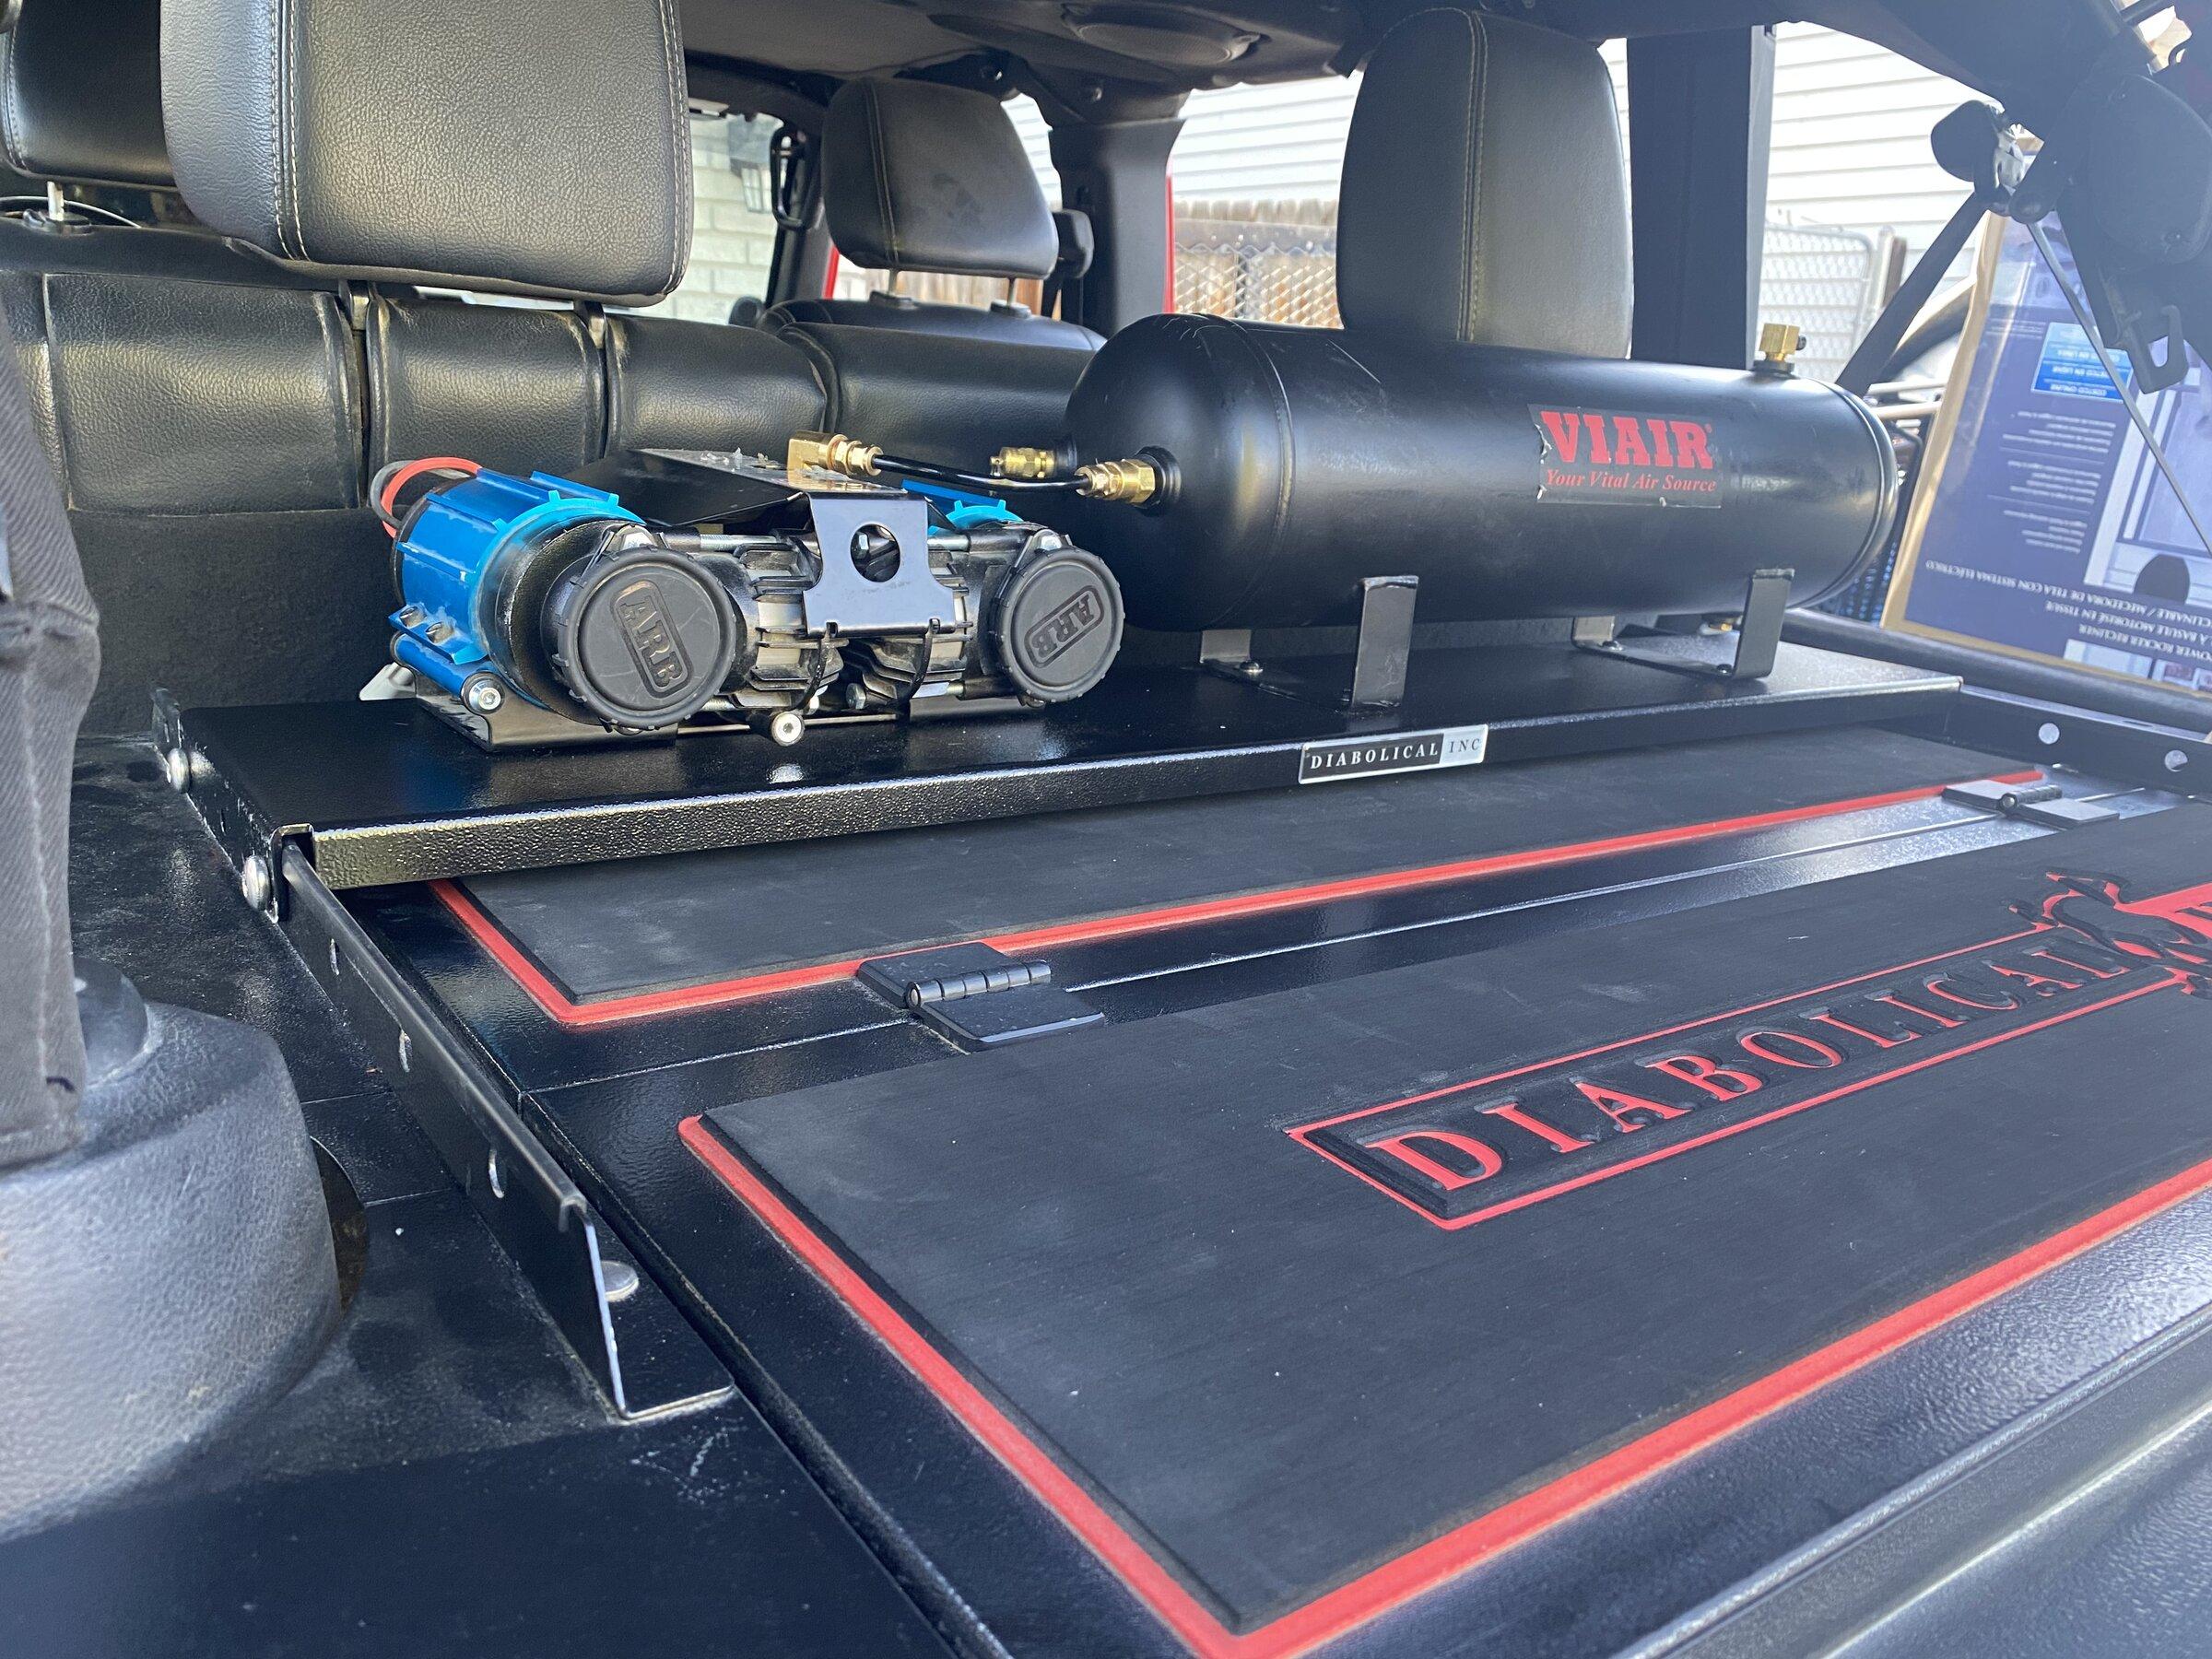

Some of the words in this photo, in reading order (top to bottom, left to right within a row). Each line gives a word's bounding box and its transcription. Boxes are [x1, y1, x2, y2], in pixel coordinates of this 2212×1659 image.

[1540, 411, 1714, 469] VIAIR
[1546, 468, 1585, 487] Your
[1589, 471, 1630, 489] Vital
[1631, 472, 1659, 490] Air
[1661, 474, 1717, 492] Source
[1976, 570, 2017, 589] SISTEMA
[2018, 580, 2042, 594] CON
[2043, 583, 2067, 599] TELA
[2070, 590, 2085, 603] DE
[2045, 600, 2079, 618] TISSUE
[2081, 608, 2097, 621] EN
[2158, 607, 2212, 629] CLINABLE
[1031, 594, 1094, 658] ARB
[618, 594, 683, 688] ARB
[2176, 644, 2212, 663] OWER
[1310, 742, 1439, 770] DIABOLICAL
[1448, 737, 1481, 754] INC
[1362, 948, 2132, 1191] DIABOLICAL
